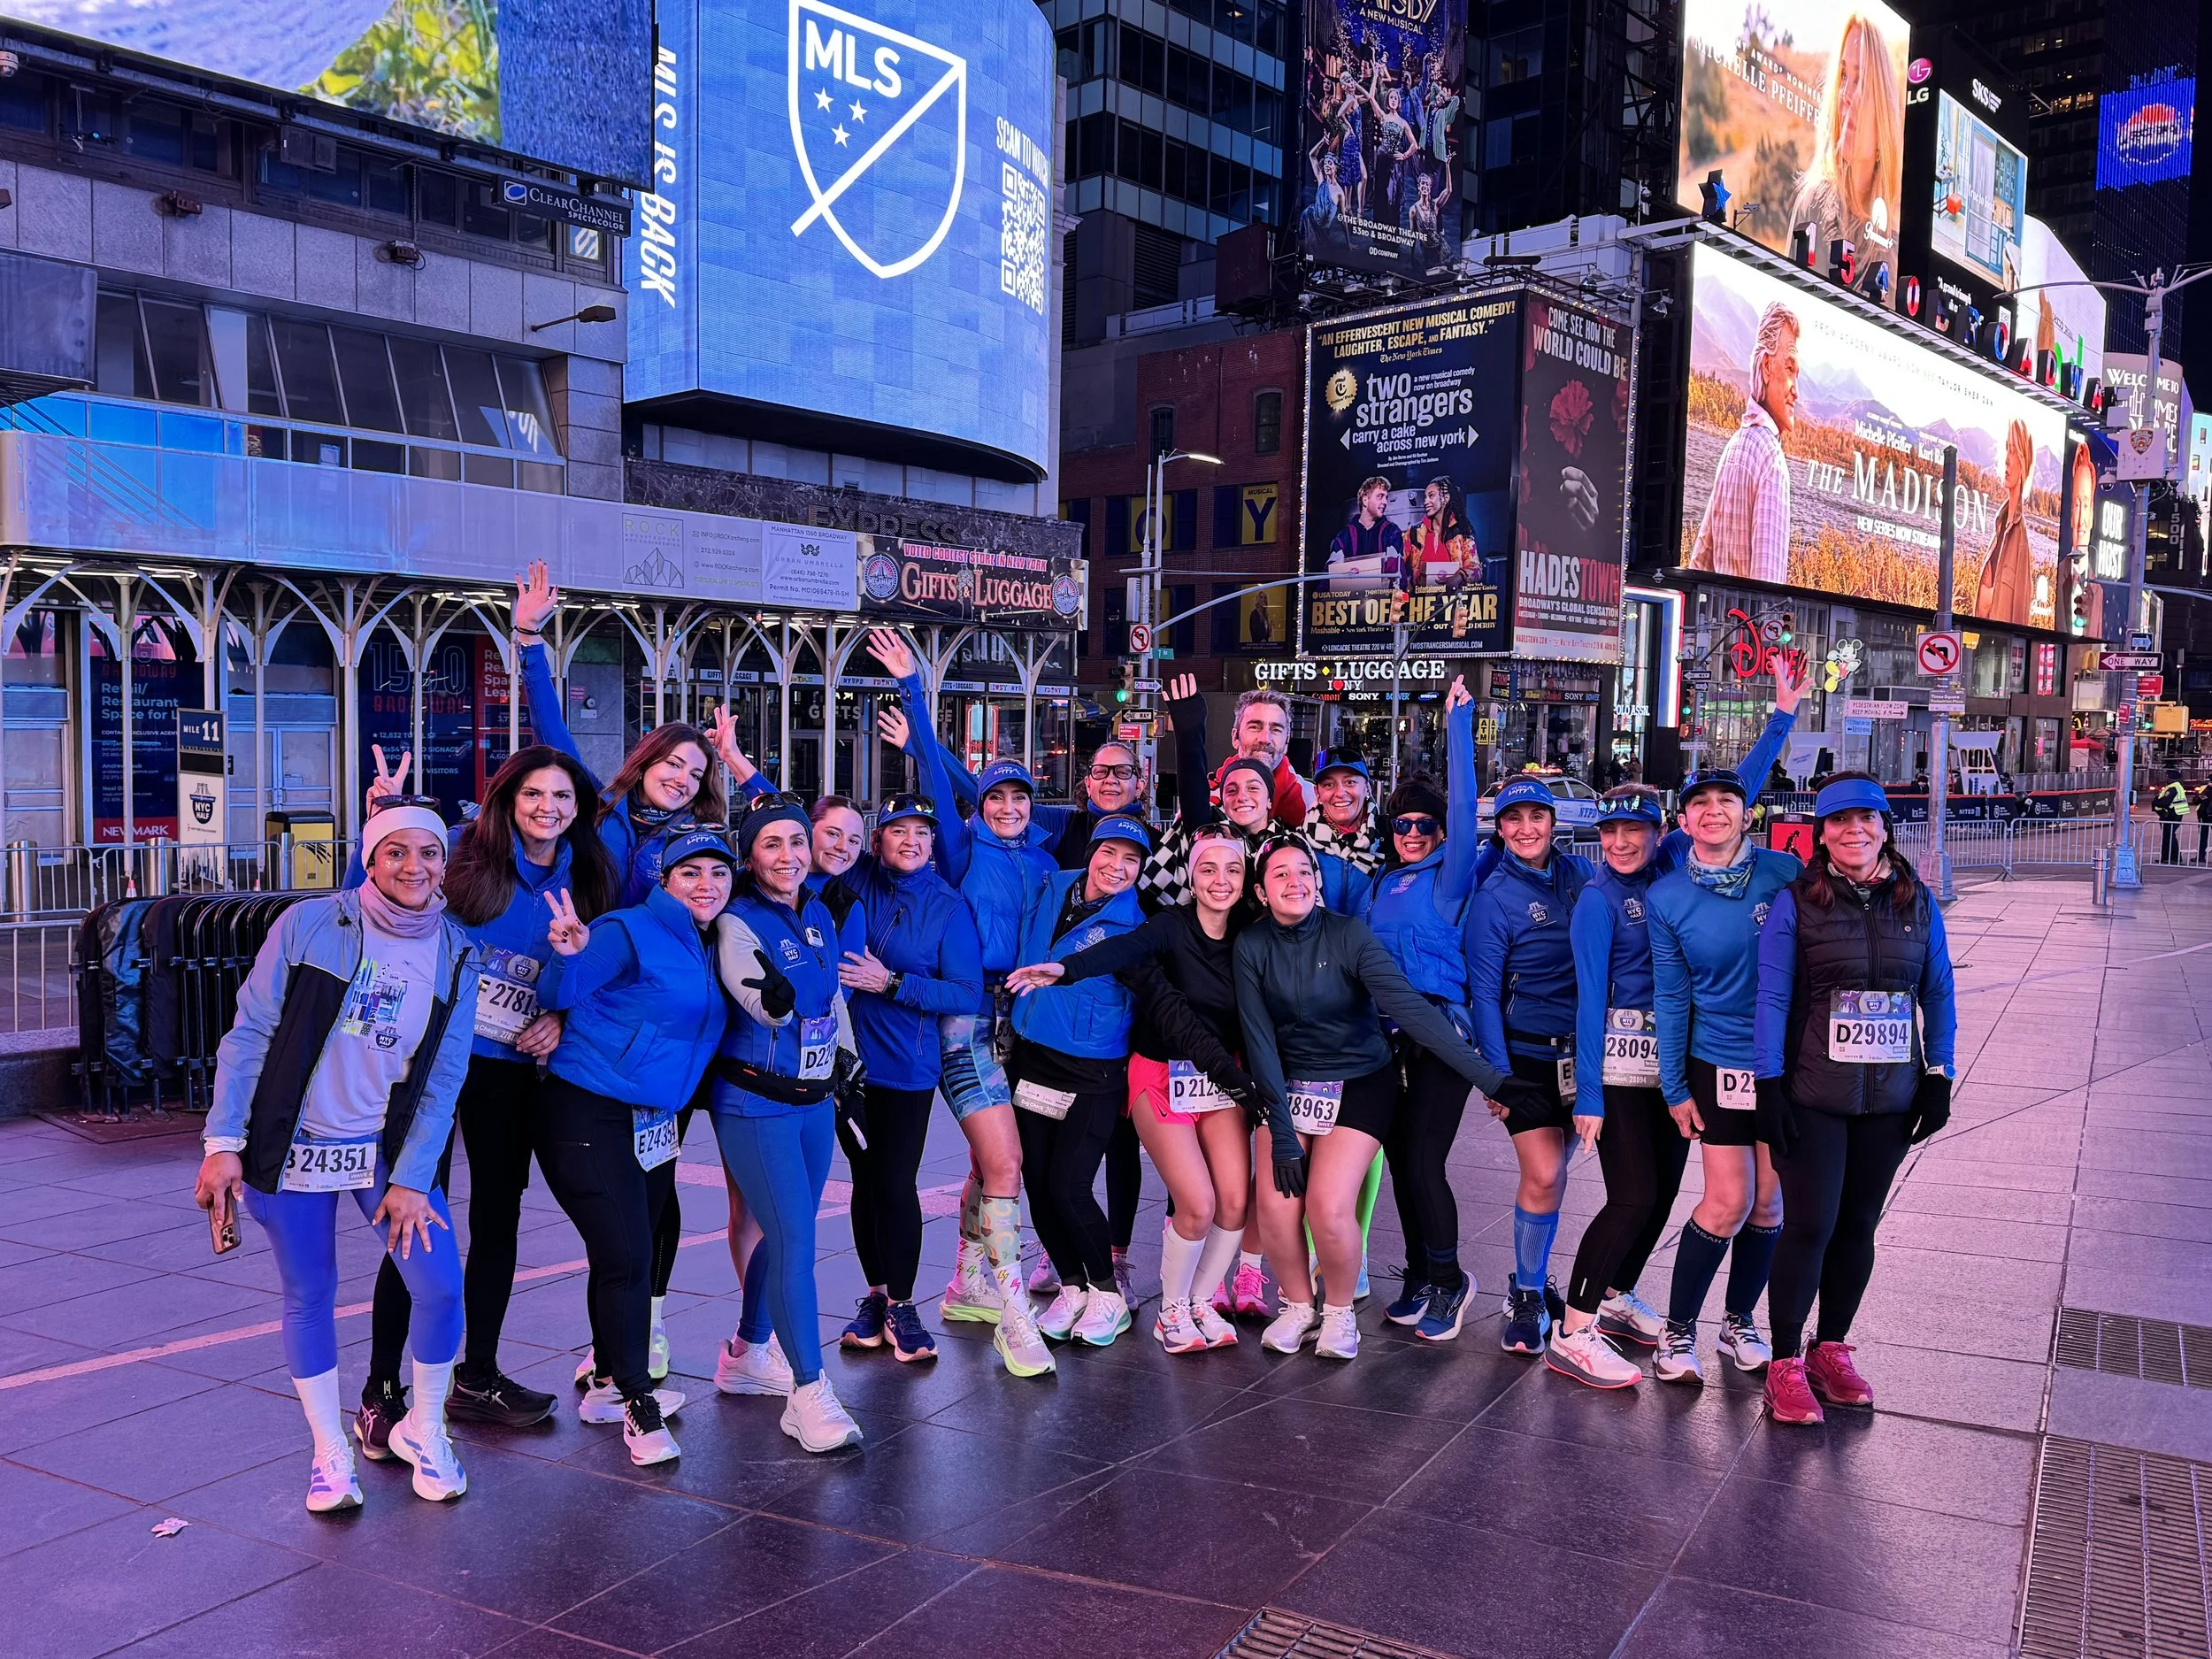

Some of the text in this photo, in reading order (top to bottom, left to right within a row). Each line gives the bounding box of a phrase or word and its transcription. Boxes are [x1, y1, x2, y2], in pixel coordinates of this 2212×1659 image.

[1359, 7, 1424, 35] A NEW MUSICAL
[805, 19, 902, 99] MLS
[1907, 87, 1930, 105] LG
[1971, 78, 1990, 107] SKS
[1771, 81, 1824, 127] PFEIFFE
[996, 115, 1048, 191] SCAN TO WATCH
[568, 211, 625, 232] SPECTACOLOR
[641, 142, 677, 310] IS BACK
[1343, 214, 1428, 242] THE BROADWAY THEATRE
[1377, 233, 1416, 248] BROADWAY
[1336, 321, 1401, 344] EFFERVESCENT
[1402, 317, 1425, 334] NEW
[1425, 311, 1469, 329] MUSICAL
[1470, 301, 1517, 322] COMEDY!
[1548, 306, 1617, 349] COME SEE HOW THE
[1334, 340, 1386, 358] LAUGHTER,
[1387, 333, 1427, 350] ESCAPE,
[1429, 334, 1439, 343] AND
[1380, 346, 1443, 364] The New Times
[1533, 324, 1628, 381] WORLD COULD BE
[1431, 370, 1452, 380] musical
[1453, 366, 1475, 377] comedy
[2107, 368, 2170, 391] WELCME
[1366, 373, 1411, 403] two
[1413, 382, 1425, 391] now
[1433, 378, 1462, 389] broadway
[1356, 388, 1473, 427] strangers
[1352, 423, 1416, 445] carry a cake
[1376, 428, 1465, 454] across new york
[1855, 419, 1886, 445] Michelle
[1886, 430, 1913, 455] Pfeiffer
[1917, 442, 1933, 463] Kurt
[1807, 459, 1846, 495] THE
[625, 518, 680, 537] ROCK
[808, 503, 960, 544] EXPRESS
[1244, 496, 1277, 541] Y
[1857, 515, 1896, 539] NEW SERIES
[2102, 500, 2124, 540] OUR
[2170, 502, 2179, 545] 1500
[625, 534, 680, 543] ARCHITECTURE
[772, 526, 805, 534] MANHATTAN
[818, 531, 847, 541] BROADWAY
[804, 558, 844, 569] UMBRELLA
[904, 543, 1048, 572] VOTED COOLEST STORE IN NEW YORK
[2098, 538, 2124, 580] HOST
[769, 583, 788, 592] Permit
[780, 575, 840, 587] www.urbanumbrella.com
[901, 561, 1053, 611] GIFTS & LUGGAGE
[1519, 549, 1621, 604] HADESTOWN
[1415, 584, 1447, 594] Entertainment
[1311, 600, 1361, 626] BEST
[1365, 598, 1391, 626] OF
[1518, 596, 1619, 618] BROADWAY'S GLOBAL SENSATION
[1328, 643, 1355, 652] LONGACRE
[1409, 641, 1483, 650] TWOSTRANGERSMUSICAL.COM
[1254, 660, 1445, 681] GIFTS LUGGAGE
[102, 695, 180, 707] Reaurant
[1631, 705, 1650, 716] ASSN.
[148, 709, 167, 720] for
[183, 725, 200, 734] MILE
[202, 721, 220, 741] 11
[195, 802, 211, 812] NYC
[103, 825, 169, 836] NEMARK
[1531, 910, 1547, 921] NYC
[1626, 906, 1643, 916] NYC
[379, 1035, 394, 1044] NYC
[480, 1025, 498, 1034] Check
[1606, 1036, 1659, 1060] 28094
[1563, 1063, 1571, 1080] E
[1724, 1072, 1737, 1092] D
[1174, 1080, 1185, 1098] D
[300, 1146, 367, 1173] 24351
